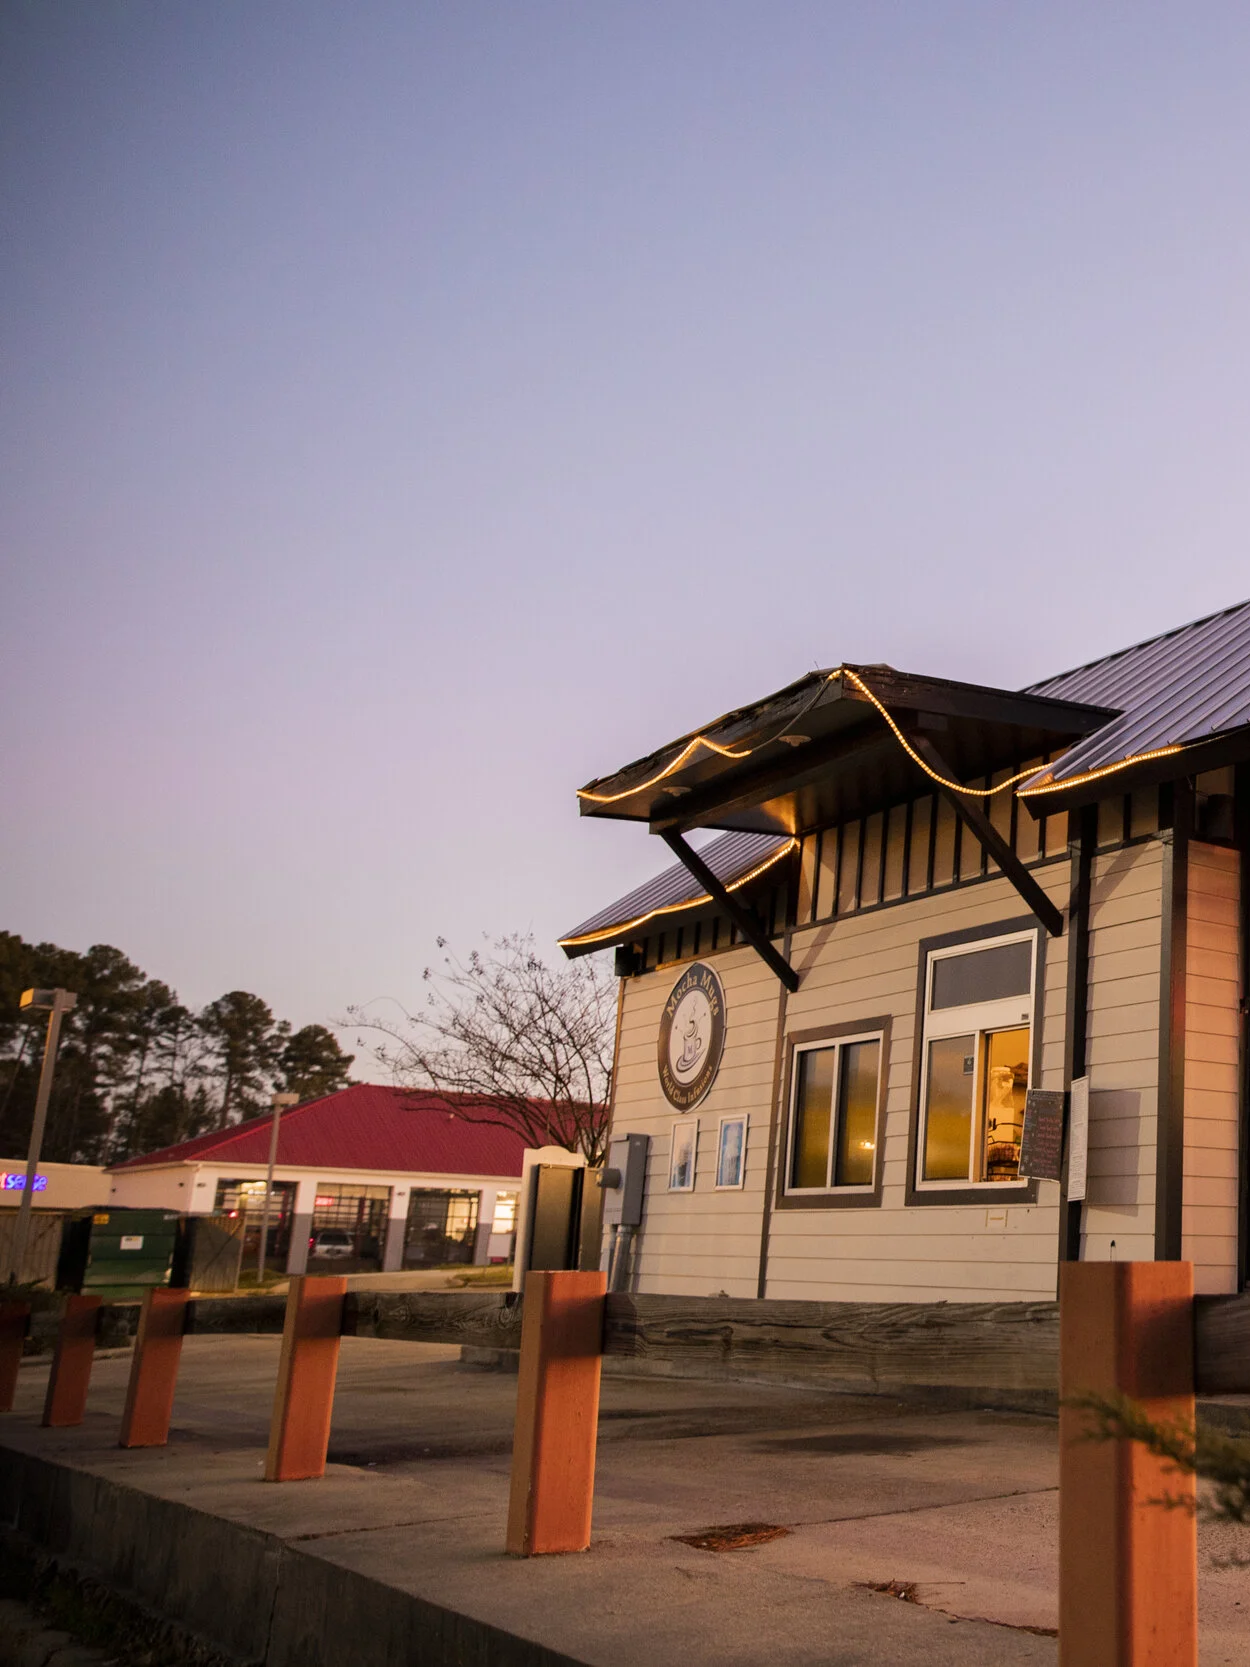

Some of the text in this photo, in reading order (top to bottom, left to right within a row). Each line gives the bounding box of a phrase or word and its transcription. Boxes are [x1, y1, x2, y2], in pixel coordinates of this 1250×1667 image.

[666, 970, 719, 1017] Mocha Mugs
[662, 1064, 675, 1096] World
